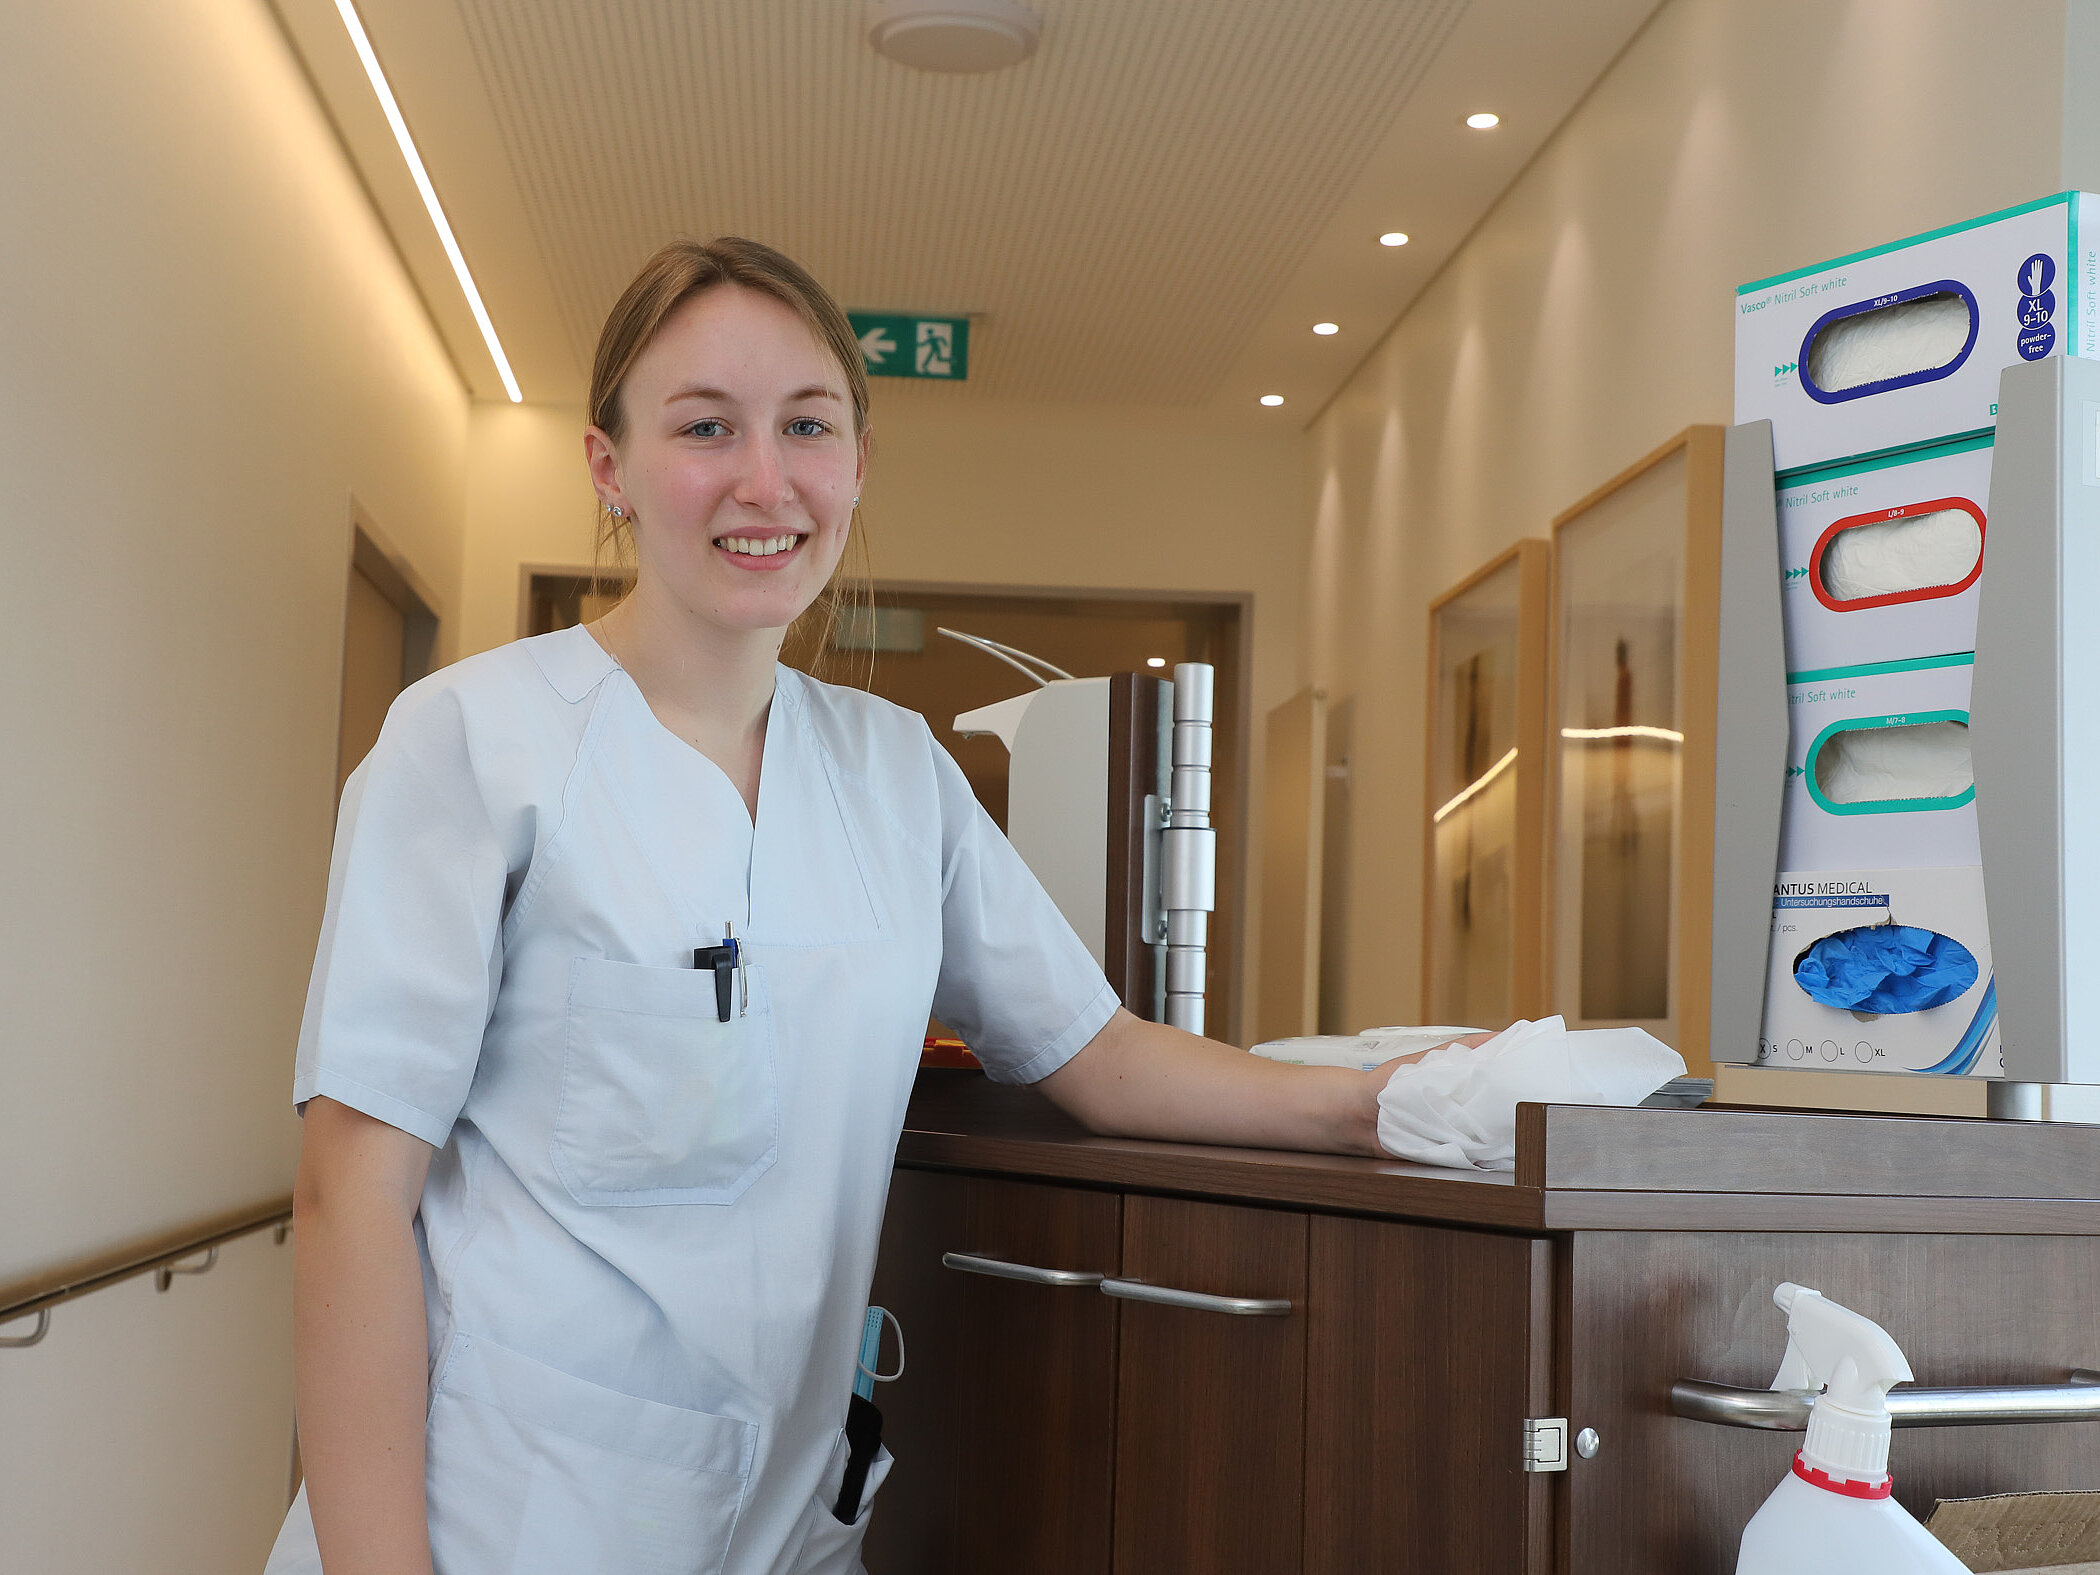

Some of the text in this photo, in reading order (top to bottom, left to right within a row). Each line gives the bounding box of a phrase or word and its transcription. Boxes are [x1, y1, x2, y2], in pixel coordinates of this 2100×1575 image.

[1774, 289, 1797, 305] Nitril
[1800, 283, 1819, 299] Soft
[1821, 276, 1848, 292] white
[2028, 298, 2044, 313] XL
[2086, 250, 2097, 352] Nitril Soft white
[2023, 309, 2049, 327] 9-10
[2020, 333, 2051, 347] powder-
[2028, 344, 2044, 354] free
[1786, 495, 1808, 508] Nitril
[1811, 490, 1829, 503] Soft
[1833, 486, 1858, 499] white
[1788, 687, 1856, 705] itril Soft white
[1817, 882, 1872, 894] MEDICAL
[1781, 896, 1882, 907] Untersuchungshandschuhe
[1805, 1046, 1813, 1054] M
[1840, 1047, 1845, 1056] L
[1874, 1048, 1886, 1057] XL
